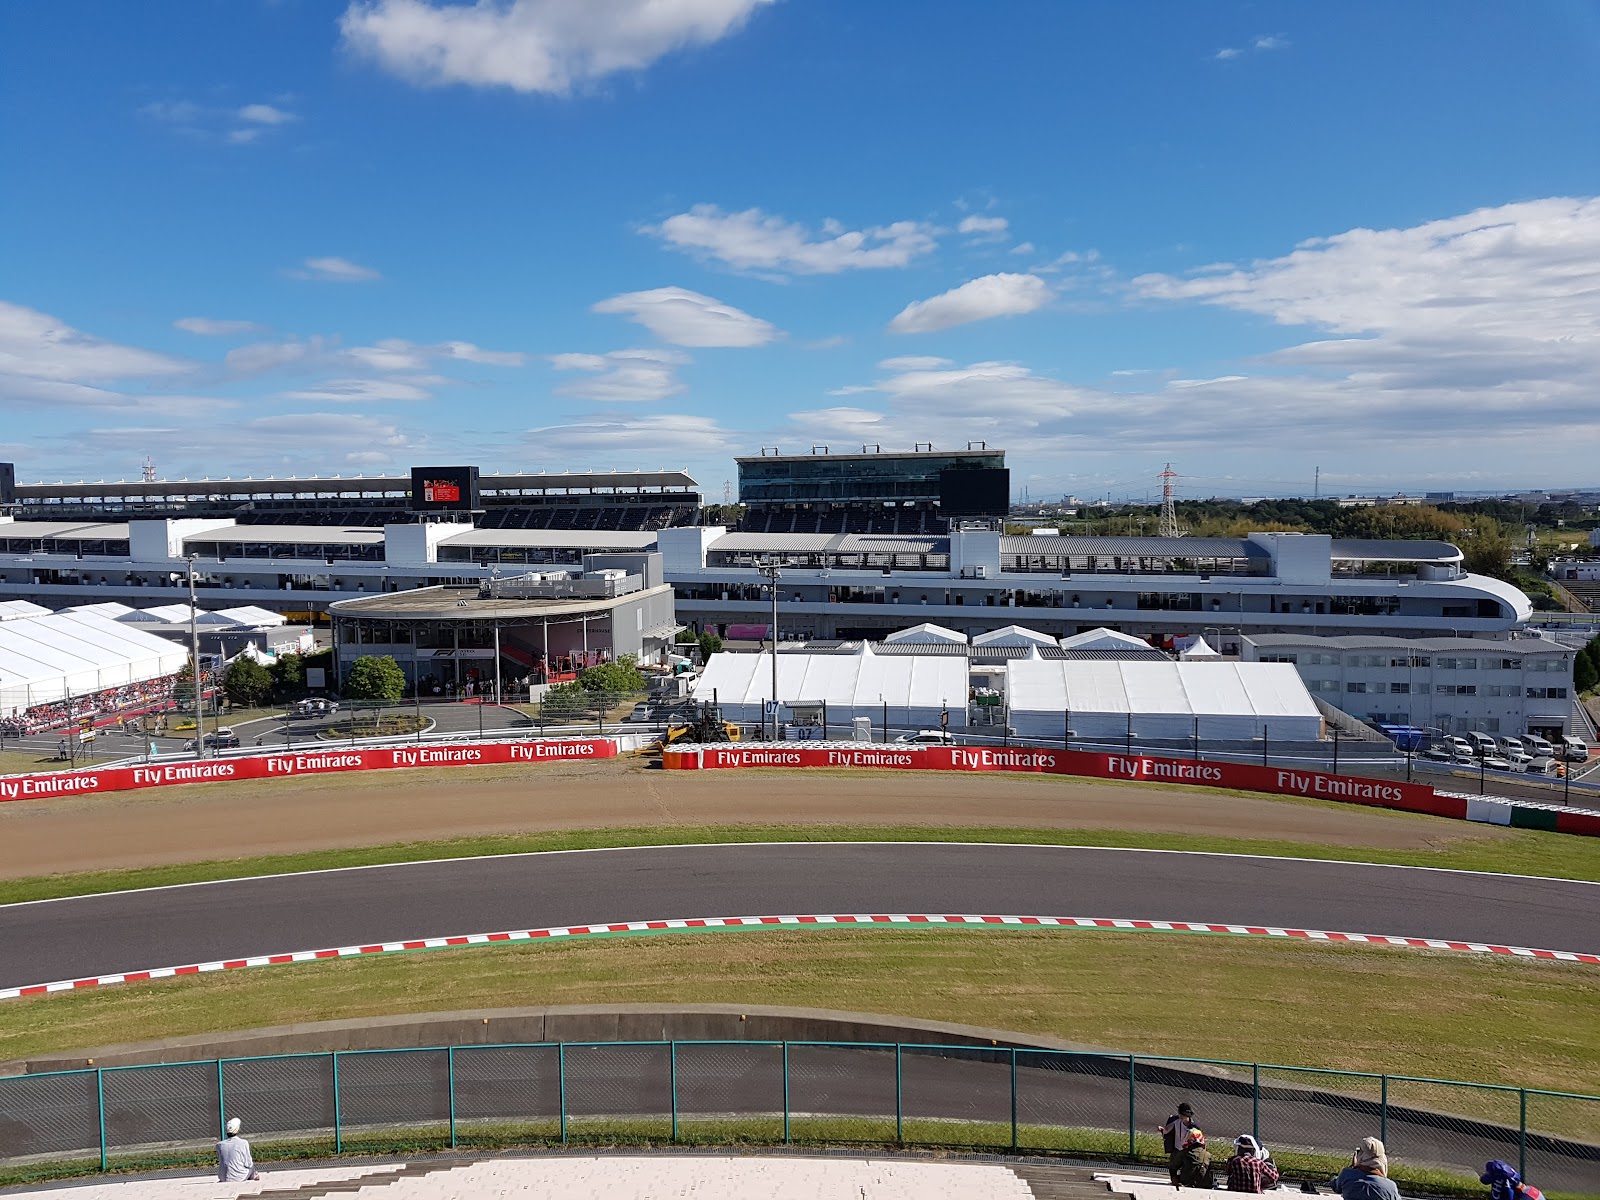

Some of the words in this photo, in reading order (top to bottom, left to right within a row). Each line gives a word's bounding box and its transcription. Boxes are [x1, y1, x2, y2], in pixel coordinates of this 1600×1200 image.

[766, 701, 779, 714] 07
[798, 728, 812, 740] 07
[392, 750, 418, 765] Fly
[419, 747, 482, 762] Emirates
[510, 746, 534, 759] Fly
[536, 743, 594, 757] Emirates
[717, 751, 741, 767] Fly
[742, 750, 801, 764] Emirates
[828, 751, 851, 768] Fly
[853, 751, 913, 766] Emirates
[951, 749, 979, 769] Fly
[982, 750, 1056, 768] Emirates
[267, 757, 293, 774] Fly
[295, 753, 362, 770] Emirates
[1108, 756, 1139, 778] Fly
[1141, 759, 1223, 781] Emirates
[133, 769, 162, 784] Fly
[164, 763, 235, 781] Emirates
[0, 782, 19, 797] ly
[22, 775, 98, 794] Emirates
[1277, 771, 1312, 794] Fly
[1314, 775, 1403, 802] Emirates
